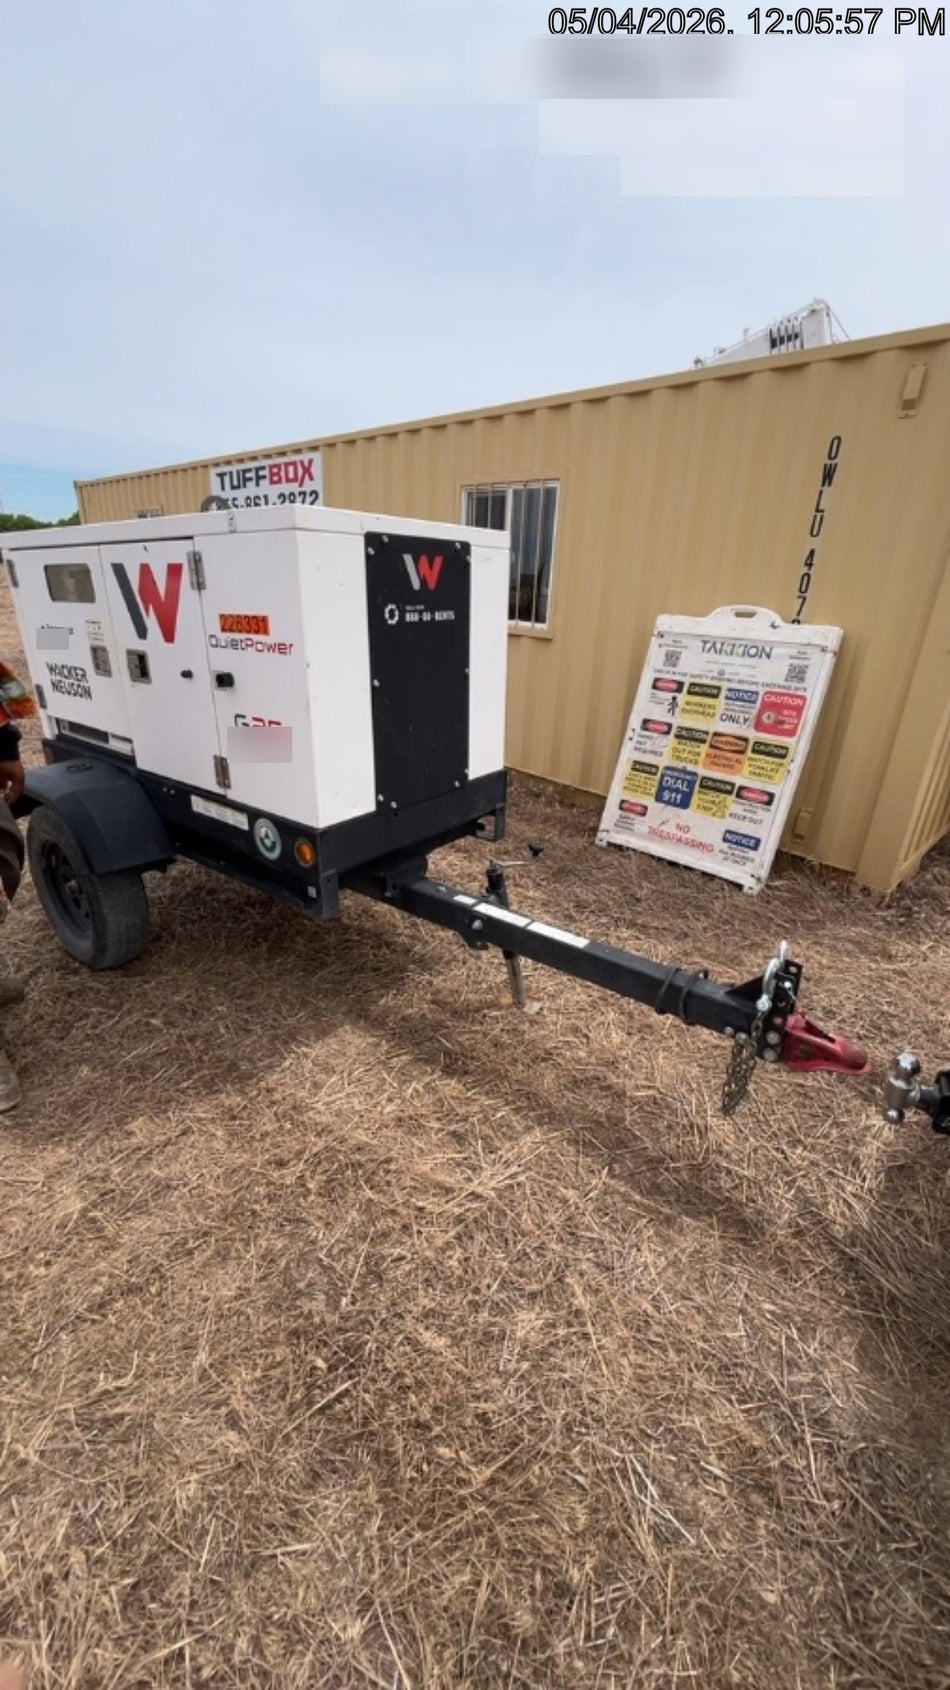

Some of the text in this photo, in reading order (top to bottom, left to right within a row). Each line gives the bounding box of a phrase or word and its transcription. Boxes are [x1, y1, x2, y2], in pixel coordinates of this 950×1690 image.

[216, 458, 314, 491] TUFFBOX
[810, 435, 842, 538] OWLU
[208, 634, 293, 656] QuietPower
[45, 661, 89, 684] WACKER
[50, 678, 93, 701] NEUSON
[690, 685, 718, 695] CAUTION
[726, 690, 758, 702] NOTICE
[763, 694, 804, 706] CAUTION
[720, 713, 750, 725] ONLY
[676, 727, 708, 741] CAUTION
[754, 743, 787, 755] CAUTION
[662, 776, 690, 793] DIAL
[702, 779, 734, 791] CAUTION
[662, 790, 682, 804] 911
[675, 823, 691, 834] NO
[648, 825, 715, 853] TRESPASSING
[725, 831, 757, 848] NOTICE
